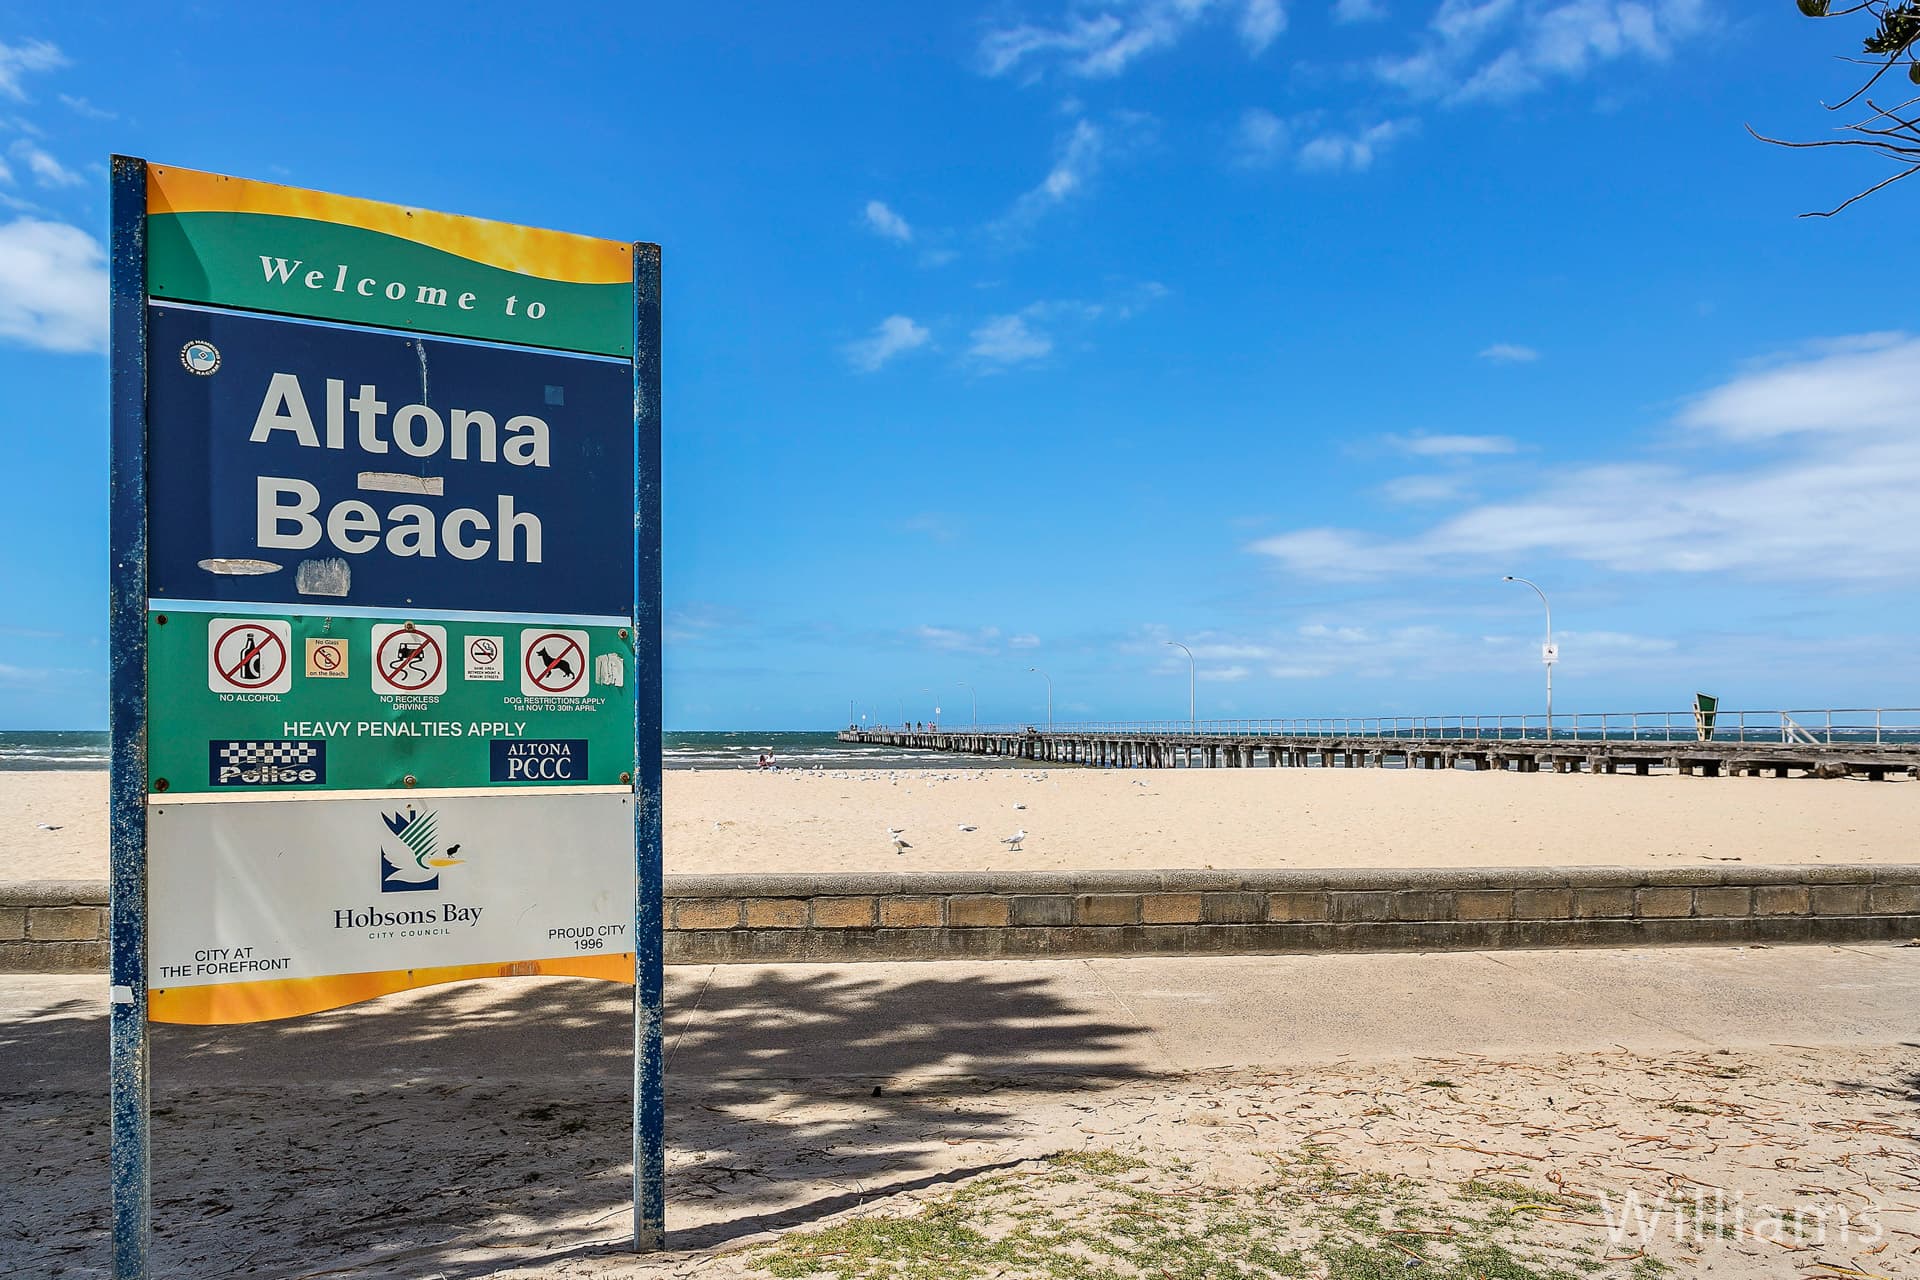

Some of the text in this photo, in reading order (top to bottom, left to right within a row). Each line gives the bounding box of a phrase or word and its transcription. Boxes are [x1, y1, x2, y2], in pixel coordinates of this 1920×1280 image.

[259, 255, 547, 319] Welcome to
[249, 372, 551, 468] Altona
[256, 475, 542, 564] Beach
[219, 694, 281, 702] NO ALCOHOL
[379, 695, 440, 704] NO RECKLESS
[503, 696, 606, 705] DOG RESTRICTIONS APPLY
[392, 703, 428, 711] DRIVING
[545, 704, 556, 712] TO
[557, 704, 573, 712] 30th
[574, 704, 597, 712] APRIL
[283, 721, 527, 737] HEAVY PENALTIES APPLY
[507, 743, 571, 756] ALTONA
[219, 765, 317, 783] Police
[507, 757, 571, 779] PCCC
[333, 903, 484, 929] Hobsons Bay
[368, 928, 450, 940] CITY COUNCIL
[549, 924, 627, 939] PROUD CITY
[574, 938, 604, 950] 1996
[194, 947, 254, 962] CITY AT
[160, 957, 292, 978] THE FOREFRONT
